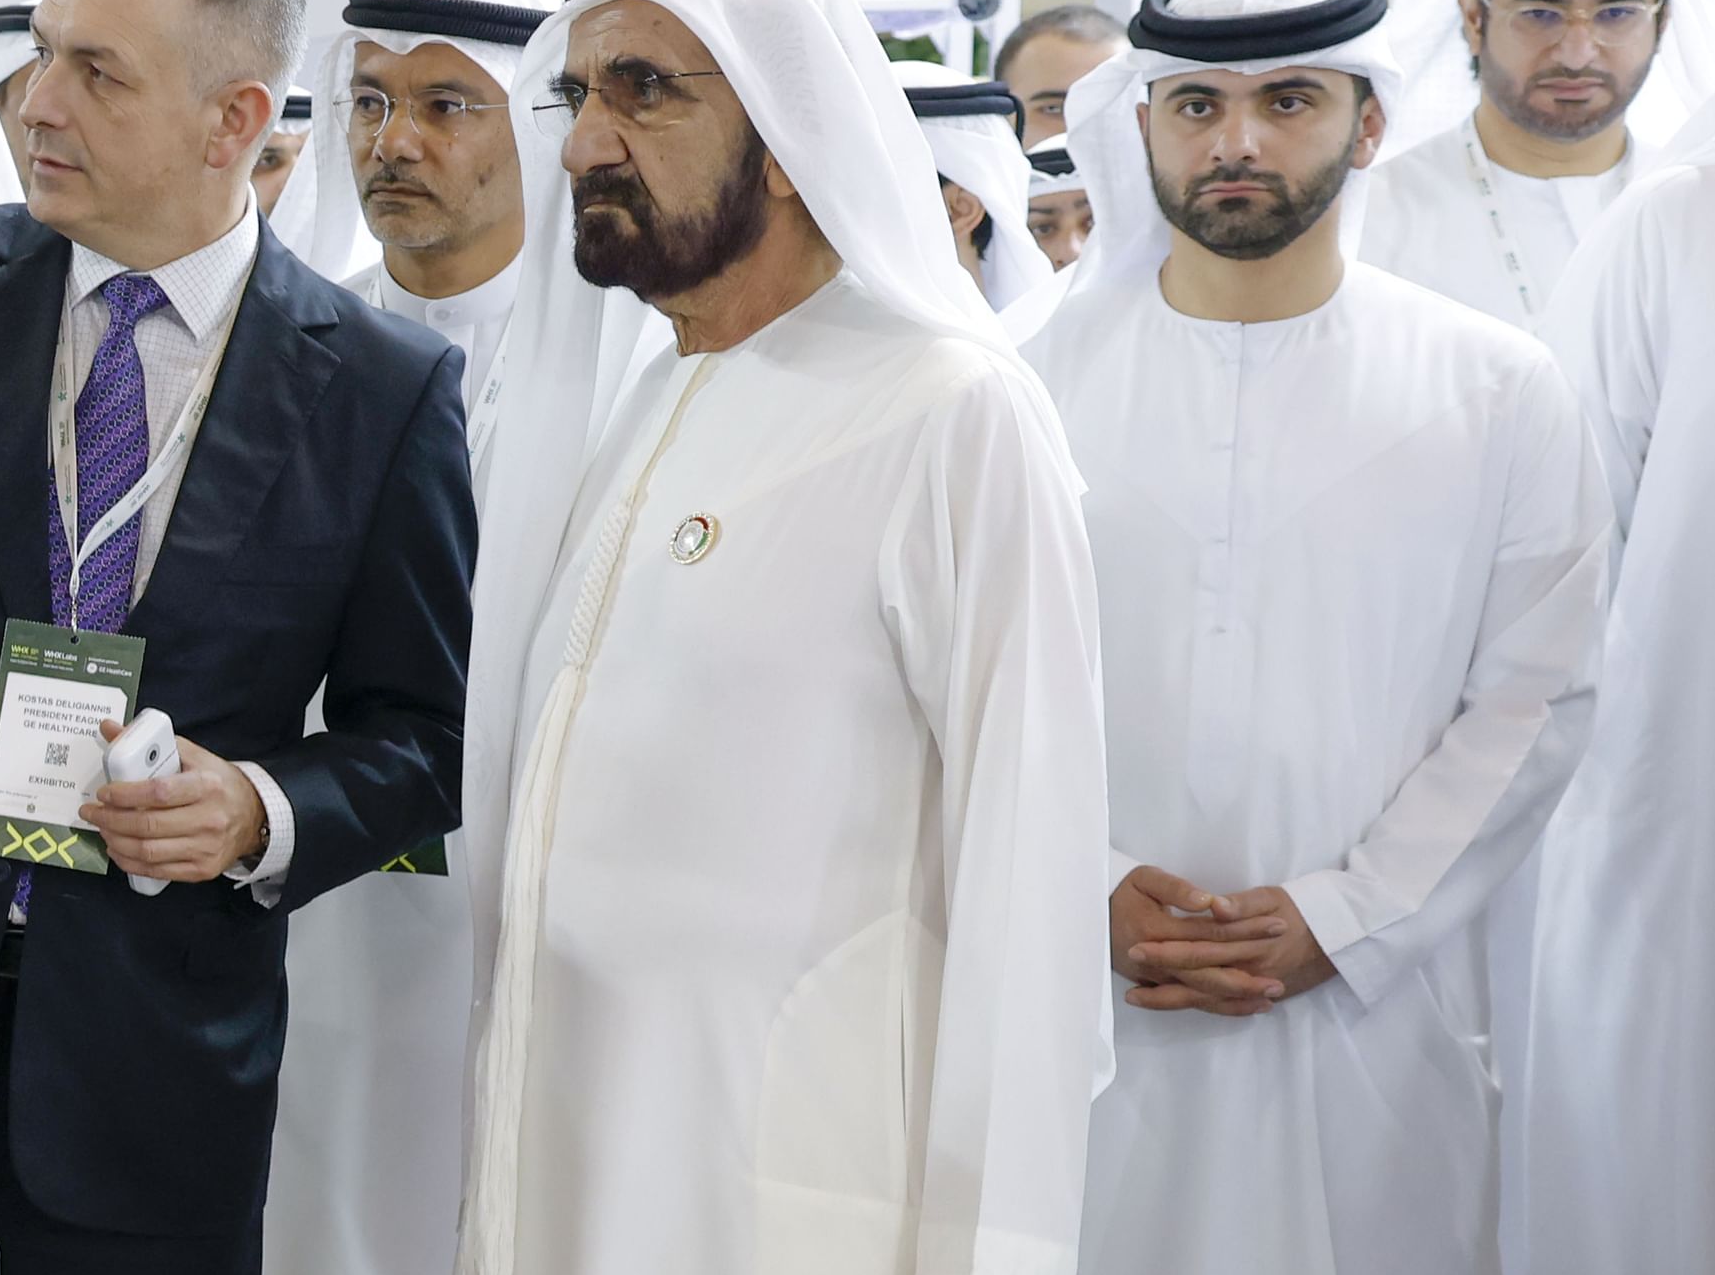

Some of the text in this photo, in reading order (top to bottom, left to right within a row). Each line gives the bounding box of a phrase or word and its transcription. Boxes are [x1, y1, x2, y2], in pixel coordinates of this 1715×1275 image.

[11, 644, 29, 655] WHX
[18, 694, 112, 715] KOSTAS DELIGIANNIS
[23, 708, 73, 723] PRESIDENT
[23, 719, 98, 738] GE HEALTHCARE
[28, 775, 76, 790] EXHIBITOR
